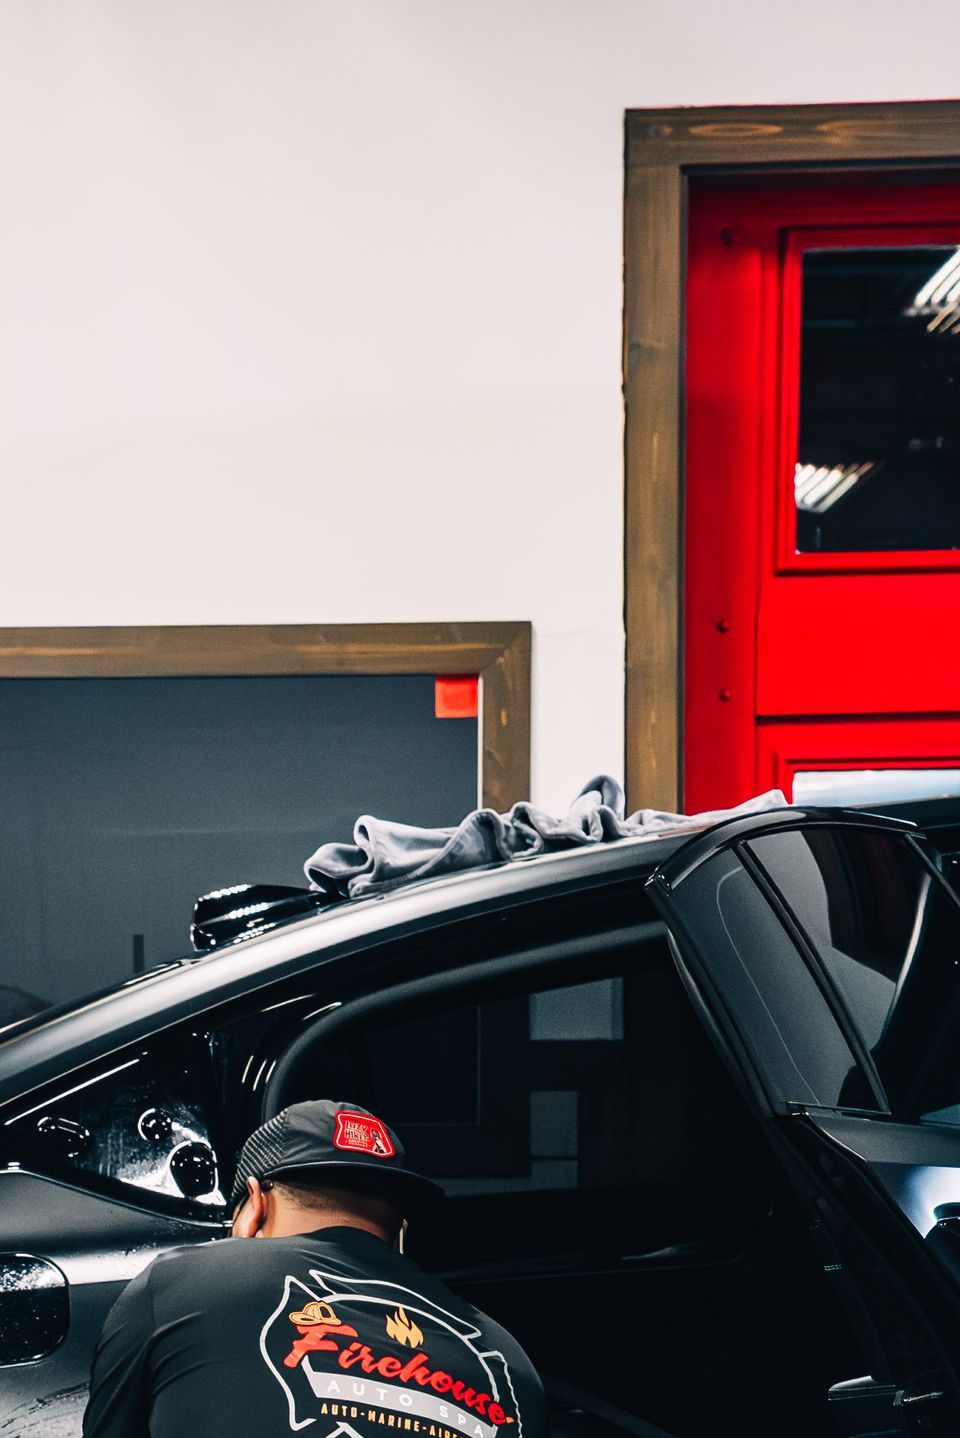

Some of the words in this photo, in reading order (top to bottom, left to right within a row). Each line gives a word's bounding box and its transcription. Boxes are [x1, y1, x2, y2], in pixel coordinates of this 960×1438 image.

[283, 1324, 507, 1425] Firehouse
[326, 1380, 413, 1407] AUTO
[439, 1404, 484, 1438] SPA
